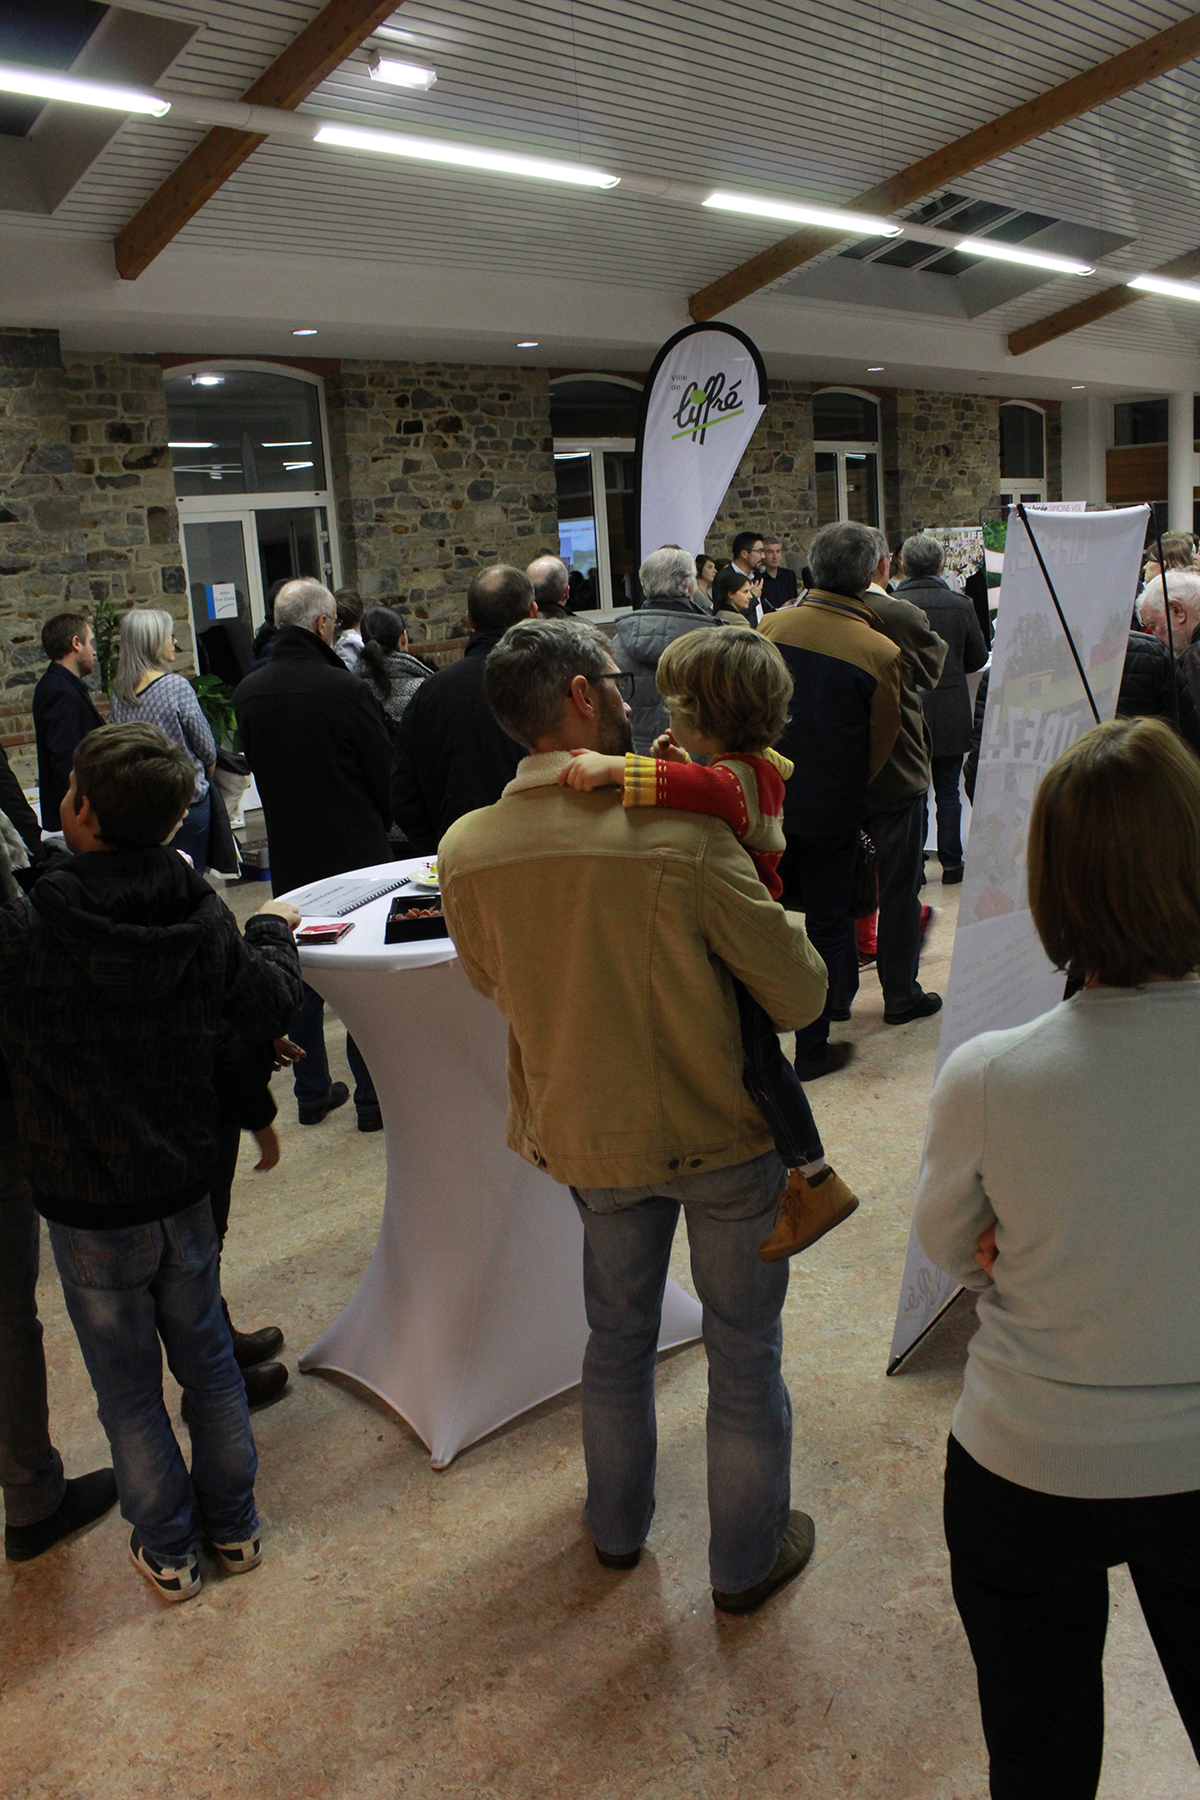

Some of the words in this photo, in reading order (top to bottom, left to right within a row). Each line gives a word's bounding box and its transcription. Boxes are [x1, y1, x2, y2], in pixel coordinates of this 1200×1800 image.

[1049, 504, 1070, 512] SIMONE
[1071, 503, 1082, 512] VEIL
[960, 530, 984, 541] LIFF
